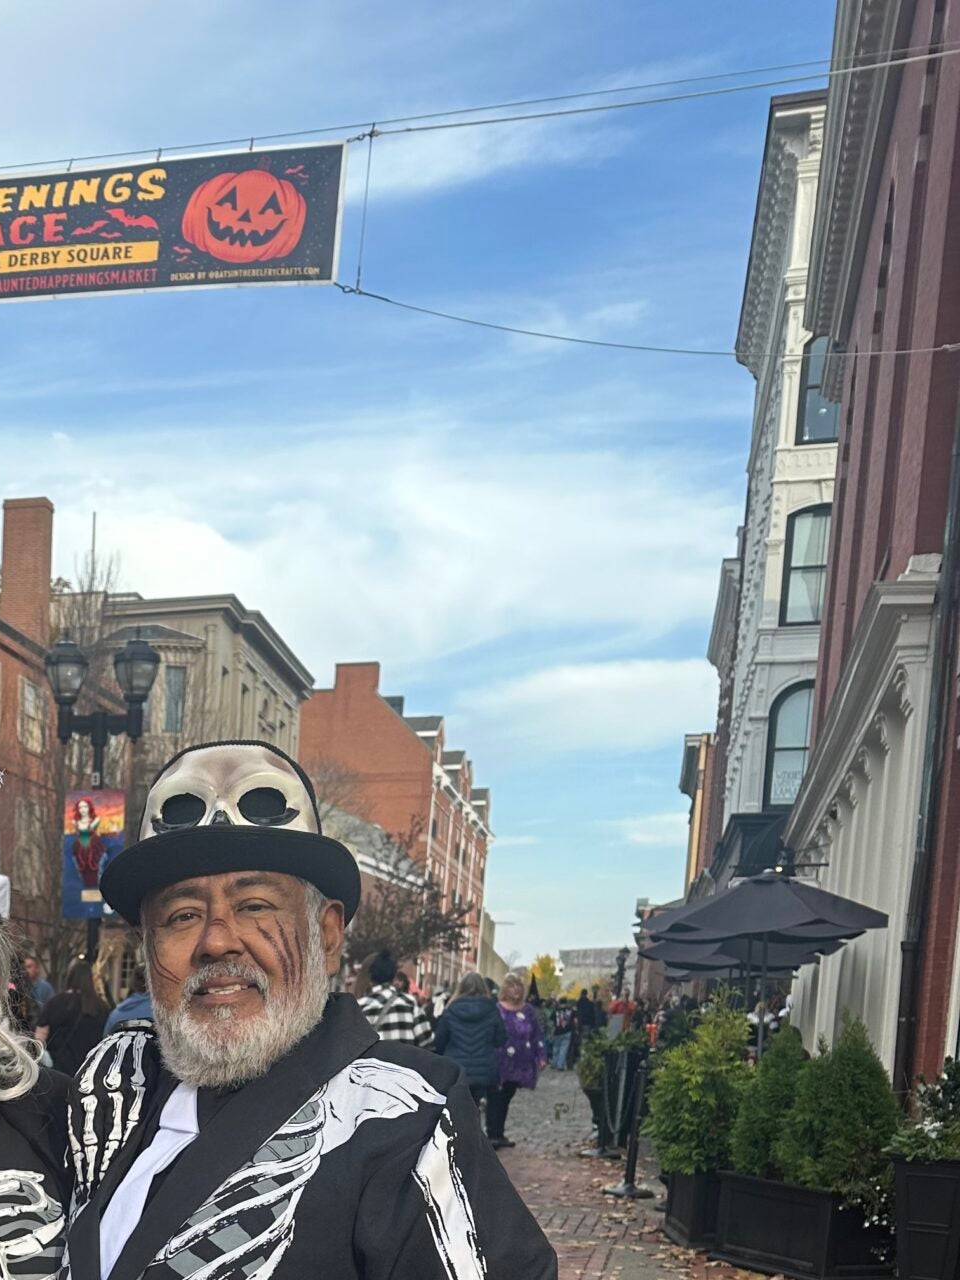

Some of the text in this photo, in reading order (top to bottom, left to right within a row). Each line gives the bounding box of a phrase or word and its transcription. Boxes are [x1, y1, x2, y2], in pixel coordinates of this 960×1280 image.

[8, 250, 61, 268] DERBY
[67, 245, 133, 264] SQUARE
[170, 271, 195, 281] DESIGN
[197, 271, 207, 280] BY
